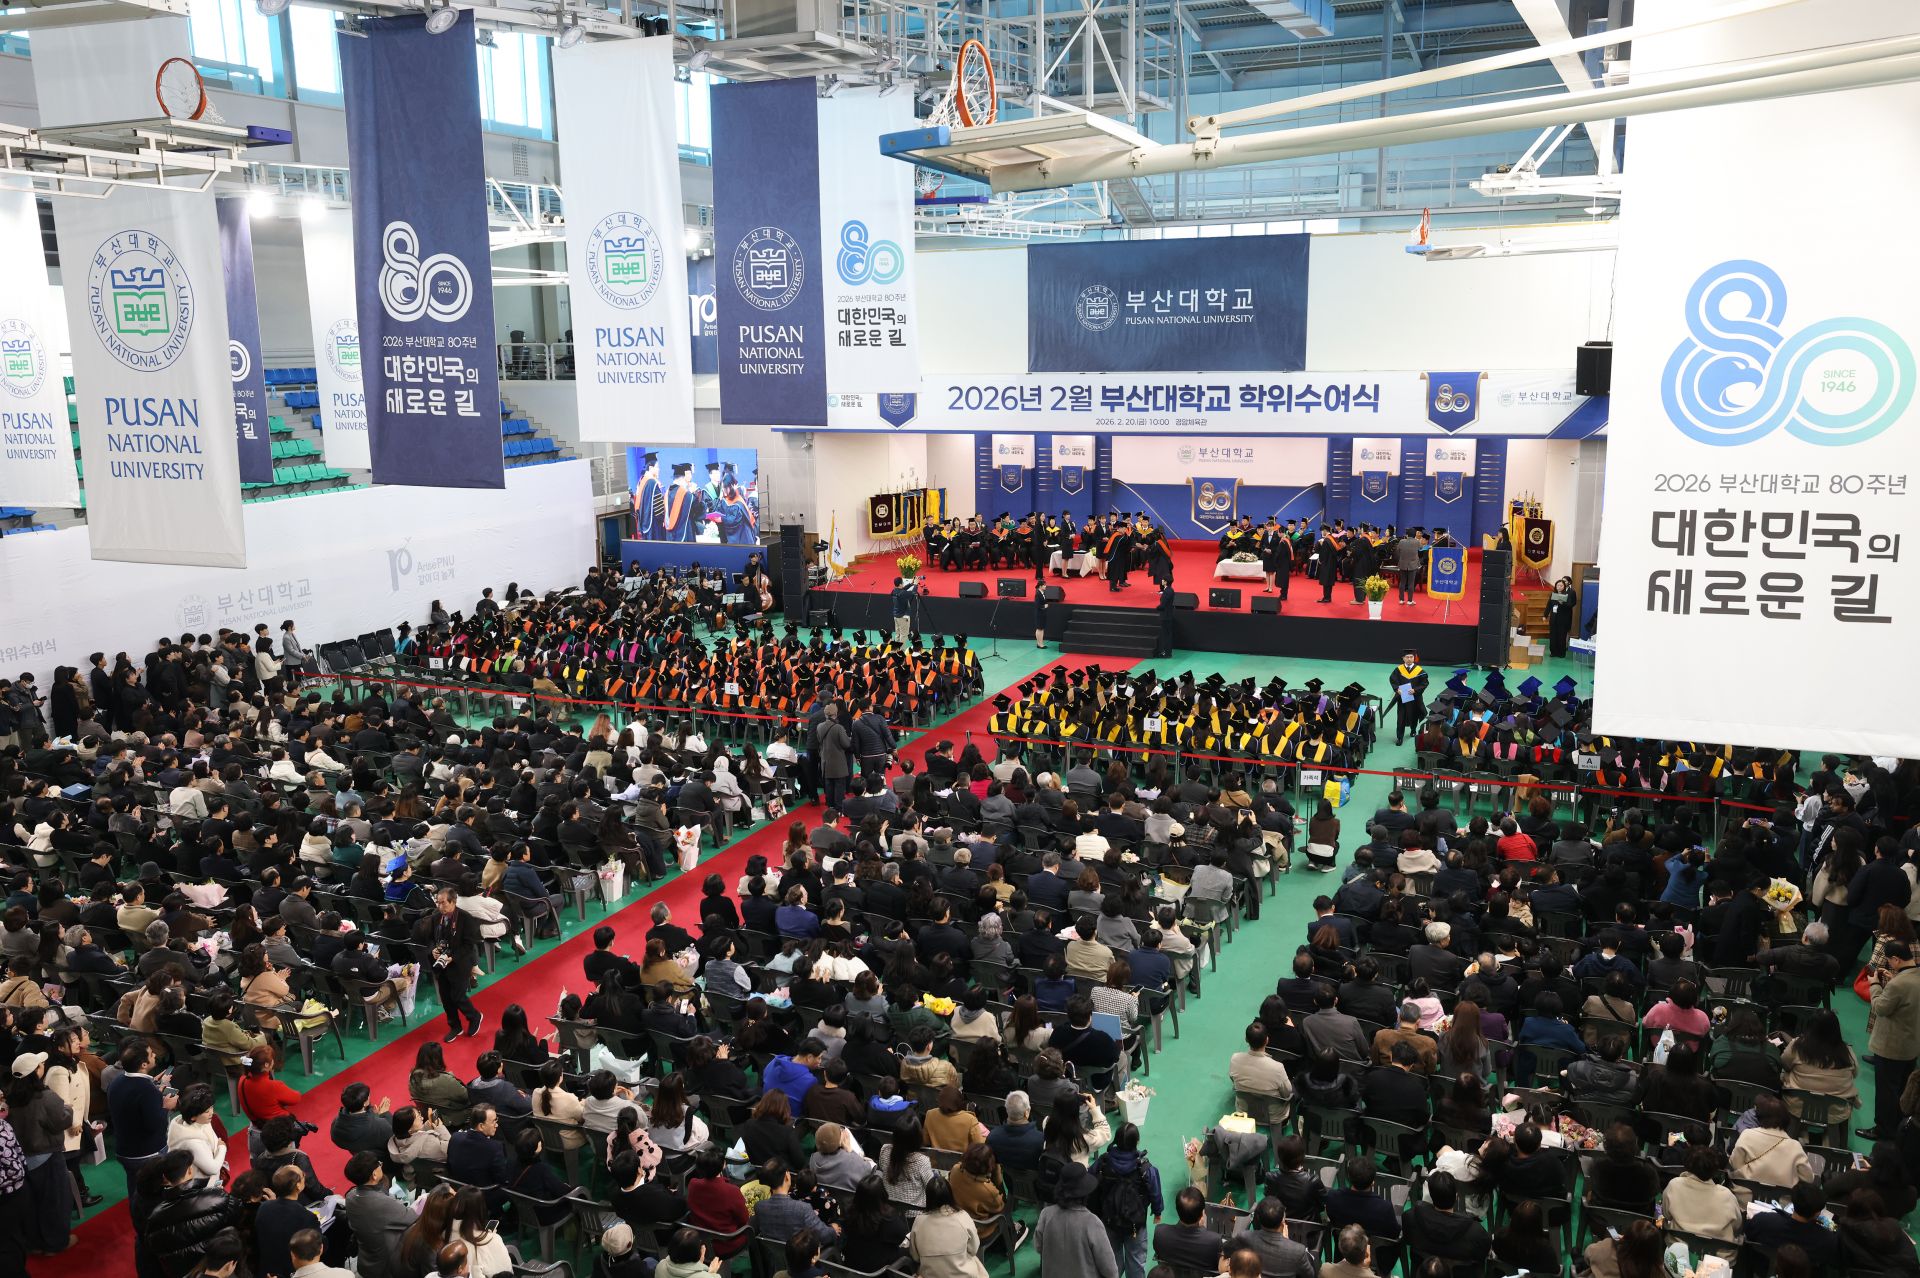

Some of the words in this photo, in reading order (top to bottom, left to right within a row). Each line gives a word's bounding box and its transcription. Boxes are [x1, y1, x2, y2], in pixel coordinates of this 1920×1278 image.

[593, 214, 653, 240] 부산대학교
[740, 228, 794, 250] 부산대학교
[94, 232, 176, 269] 부산대학교
[588, 252, 600, 284] PUSAN
[598, 284, 640, 307] NATIONAL
[640, 249, 662, 302] UNIVERSITY
[735, 260, 745, 289] PUSAN
[744, 289, 781, 308] NATIONAL
[782, 258, 802, 304] UNIVERSITY
[1126, 288, 1254, 314] 부산대학교
[90, 286, 107, 334] PUSAN
[106, 334, 162, 368] NATIONAL
[162, 284, 190, 360] UNIVERSITY
[838, 307, 906, 326] 대한민국의
[1125, 316, 1154, 325] PUSAN
[1156, 315, 1201, 324] NATIONAL
[1203, 314, 1254, 324] UNIVERSITY
[382, 336, 404, 348] 2026
[406, 336, 445, 348] 부산대학교
[596, 327, 664, 348] PUSAN
[740, 326, 804, 343] PUSAN
[838, 329, 882, 347] 새로운
[888, 328, 906, 347] 길
[596, 352, 666, 366] NATIONAL
[740, 347, 804, 359] NATIONAL
[384, 354, 479, 384] 대한민국의
[598, 372, 666, 384] UNIVERSITY
[740, 364, 804, 374] UNIVERSITY
[1823, 369, 1856, 378] SINCE
[1820, 381, 1857, 392] 1946
[333, 394, 364, 407] PUSA
[386, 388, 446, 416] 새로운
[454, 389, 481, 416] 길
[948, 385, 1042, 412] 2026년
[1050, 385, 1092, 412] 2월
[1100, 384, 1230, 412] 부산대학교
[1239, 384, 1380, 413] 학위수여식
[1518, 392, 1572, 401] 부산대학교
[2, 413, 53, 430] PUSAN
[104, 398, 200, 428] PUSAN
[334, 410, 366, 418] NATION
[243, 423, 258, 440] 길
[336, 422, 368, 430] UNIVERS
[4, 434, 56, 445] NATIONAL
[108, 434, 202, 454] NATIONAL
[6, 449, 56, 460] UNIVERSITY
[1199, 448, 1254, 458] 부산대학교
[110, 460, 204, 480] UNIVERSITY
[1654, 473, 1712, 493] 2026
[1719, 474, 1820, 494] 부산대학교
[1829, 474, 1907, 496] 80주년
[1651, 508, 1900, 564] 대한민국의
[217, 578, 312, 615] 부산대학교
[1647, 568, 1804, 620] 새로운
[1830, 574, 1892, 624] 길
